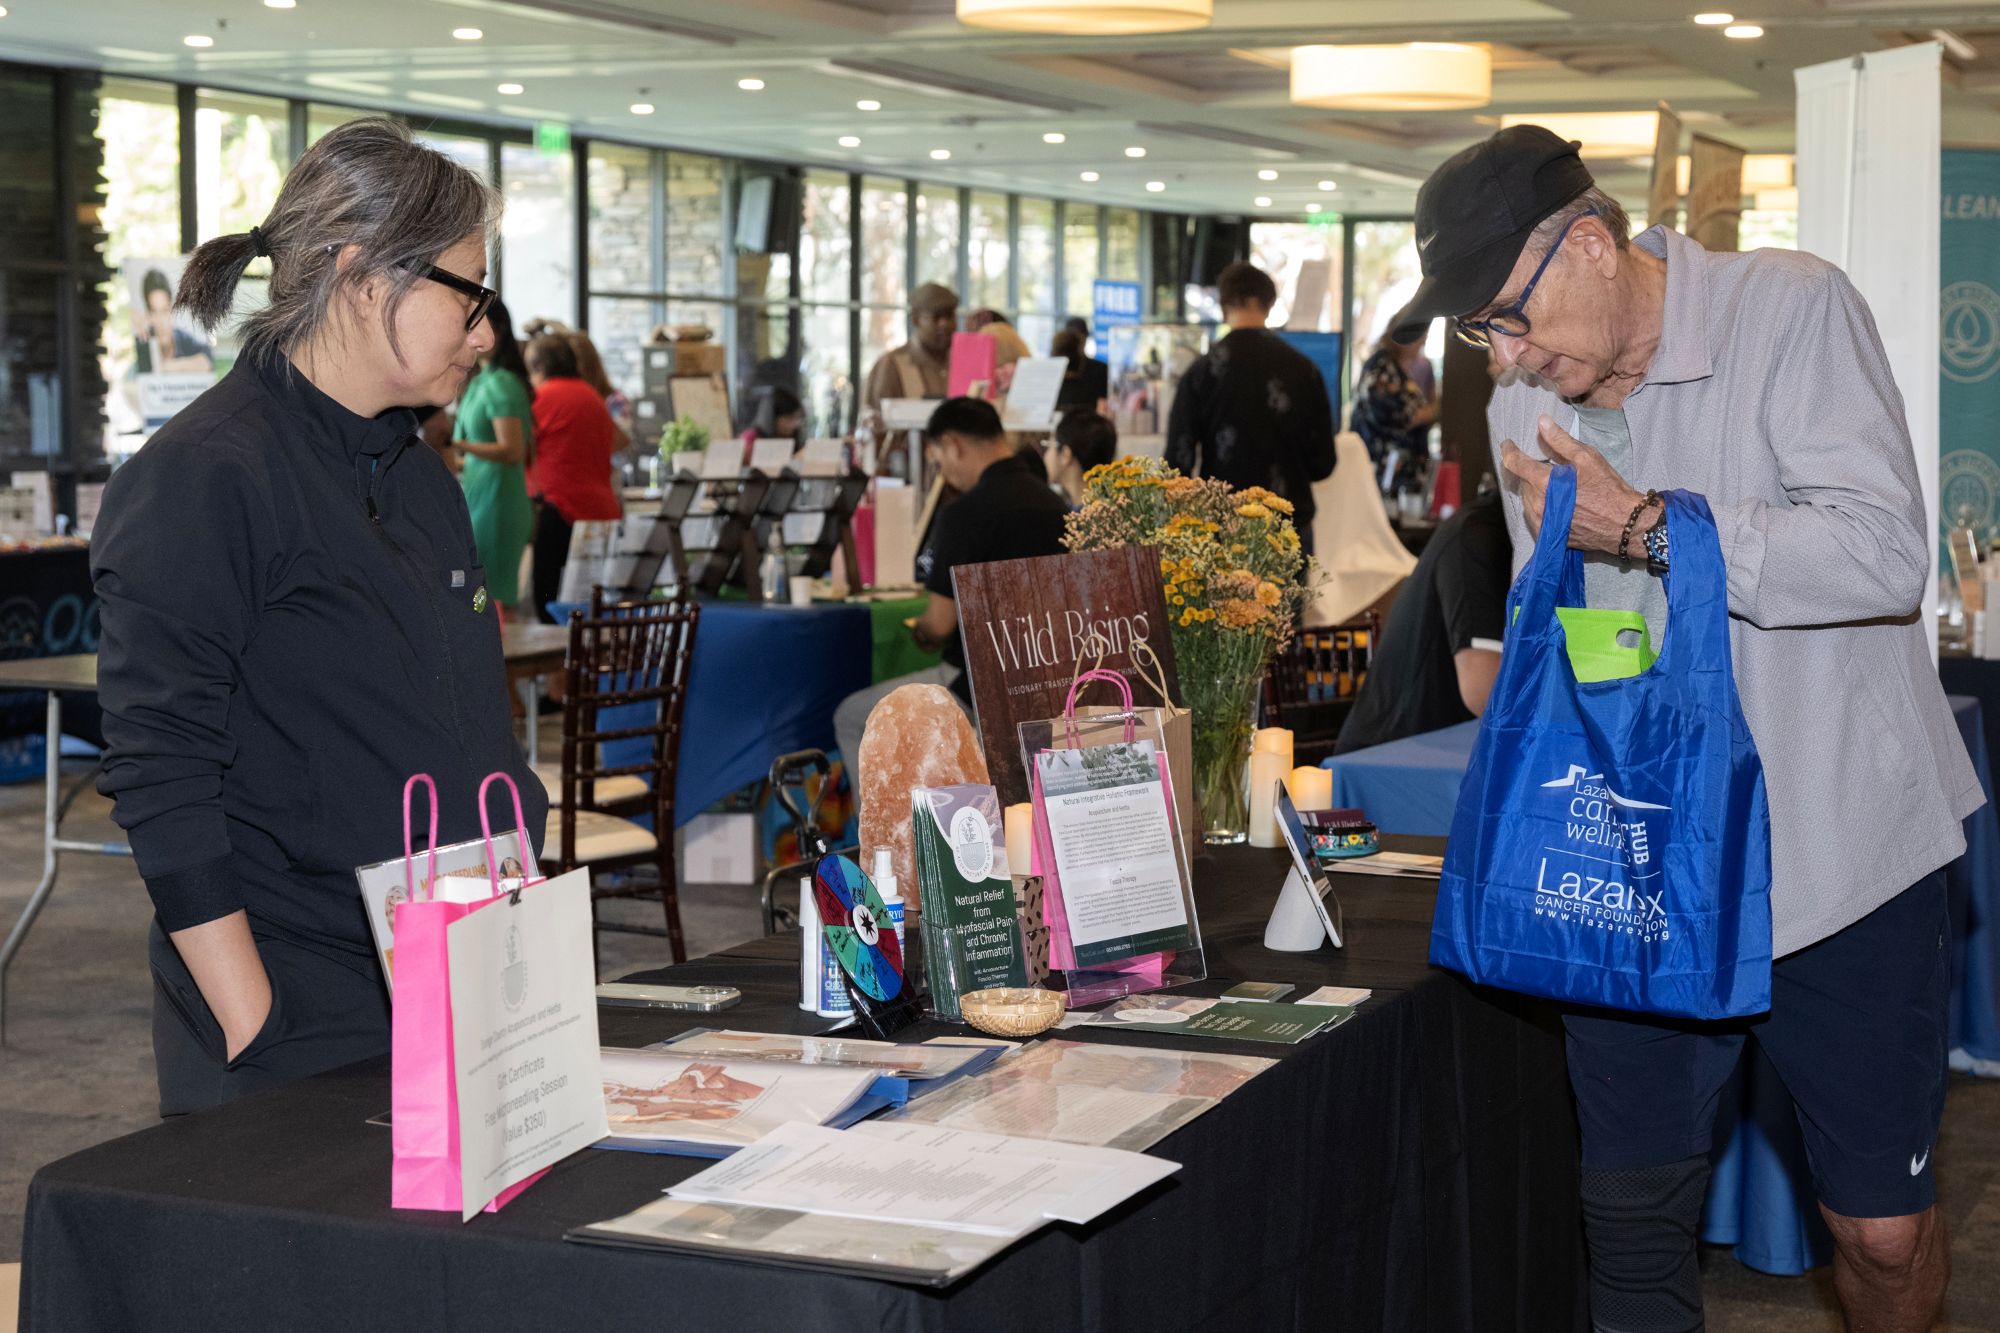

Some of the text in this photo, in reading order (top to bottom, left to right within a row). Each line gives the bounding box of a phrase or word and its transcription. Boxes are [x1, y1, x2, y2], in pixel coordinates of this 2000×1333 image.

[986, 605, 1154, 673] Wild Rising
[1007, 682, 1043, 696] VISIONARY
[1575, 779, 1611, 800] Laza
[1630, 821, 1650, 865] HUB
[954, 888, 1004, 907] Natural Relief
[973, 906, 991, 918] from
[996, 915, 1013, 928] Pain
[1535, 894, 1668, 933] CANCER FOUNDION
[966, 931, 1008, 947] and Chronic
[508, 1057, 545, 1084] Certificate
[540, 1074, 568, 1097] Session
